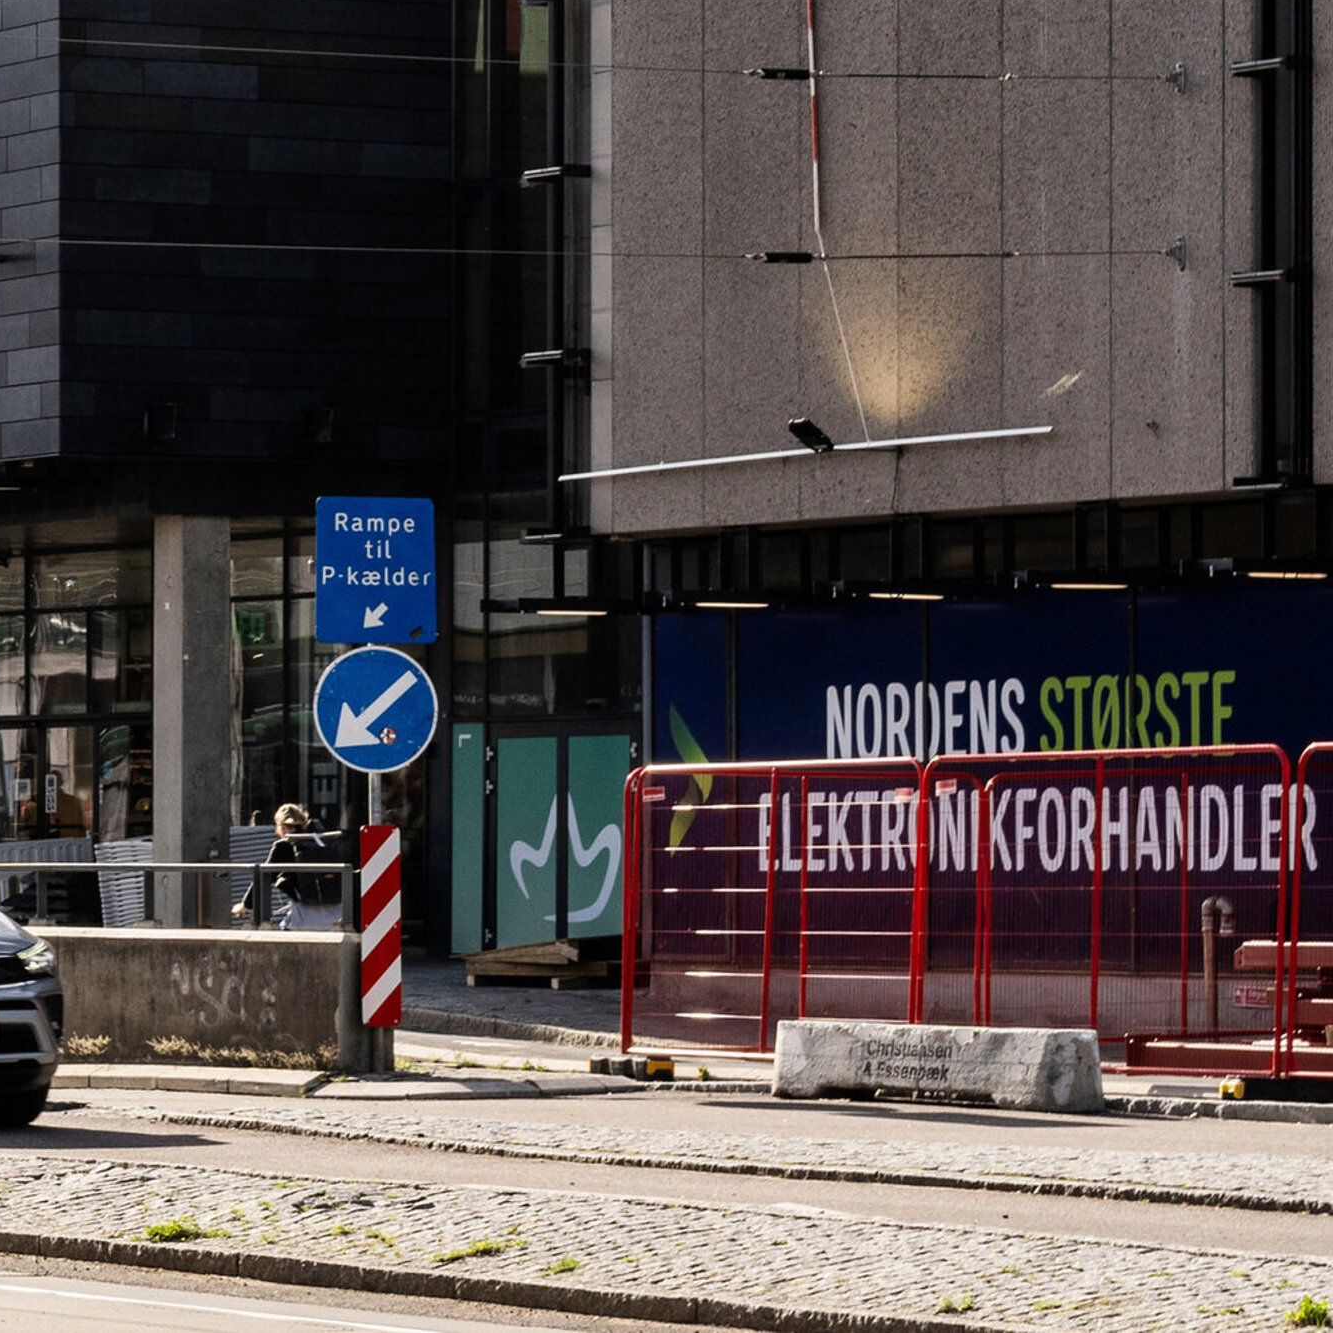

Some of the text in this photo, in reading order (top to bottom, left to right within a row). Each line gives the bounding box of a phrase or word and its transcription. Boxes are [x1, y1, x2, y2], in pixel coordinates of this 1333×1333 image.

[334, 512, 416, 537] Rampe
[364, 539, 392, 559] til
[322, 565, 432, 586] P-kælder
[826, 670, 1236, 761] NORDENS STØRSTE
[865, 1038, 954, 1060] Christiansen
